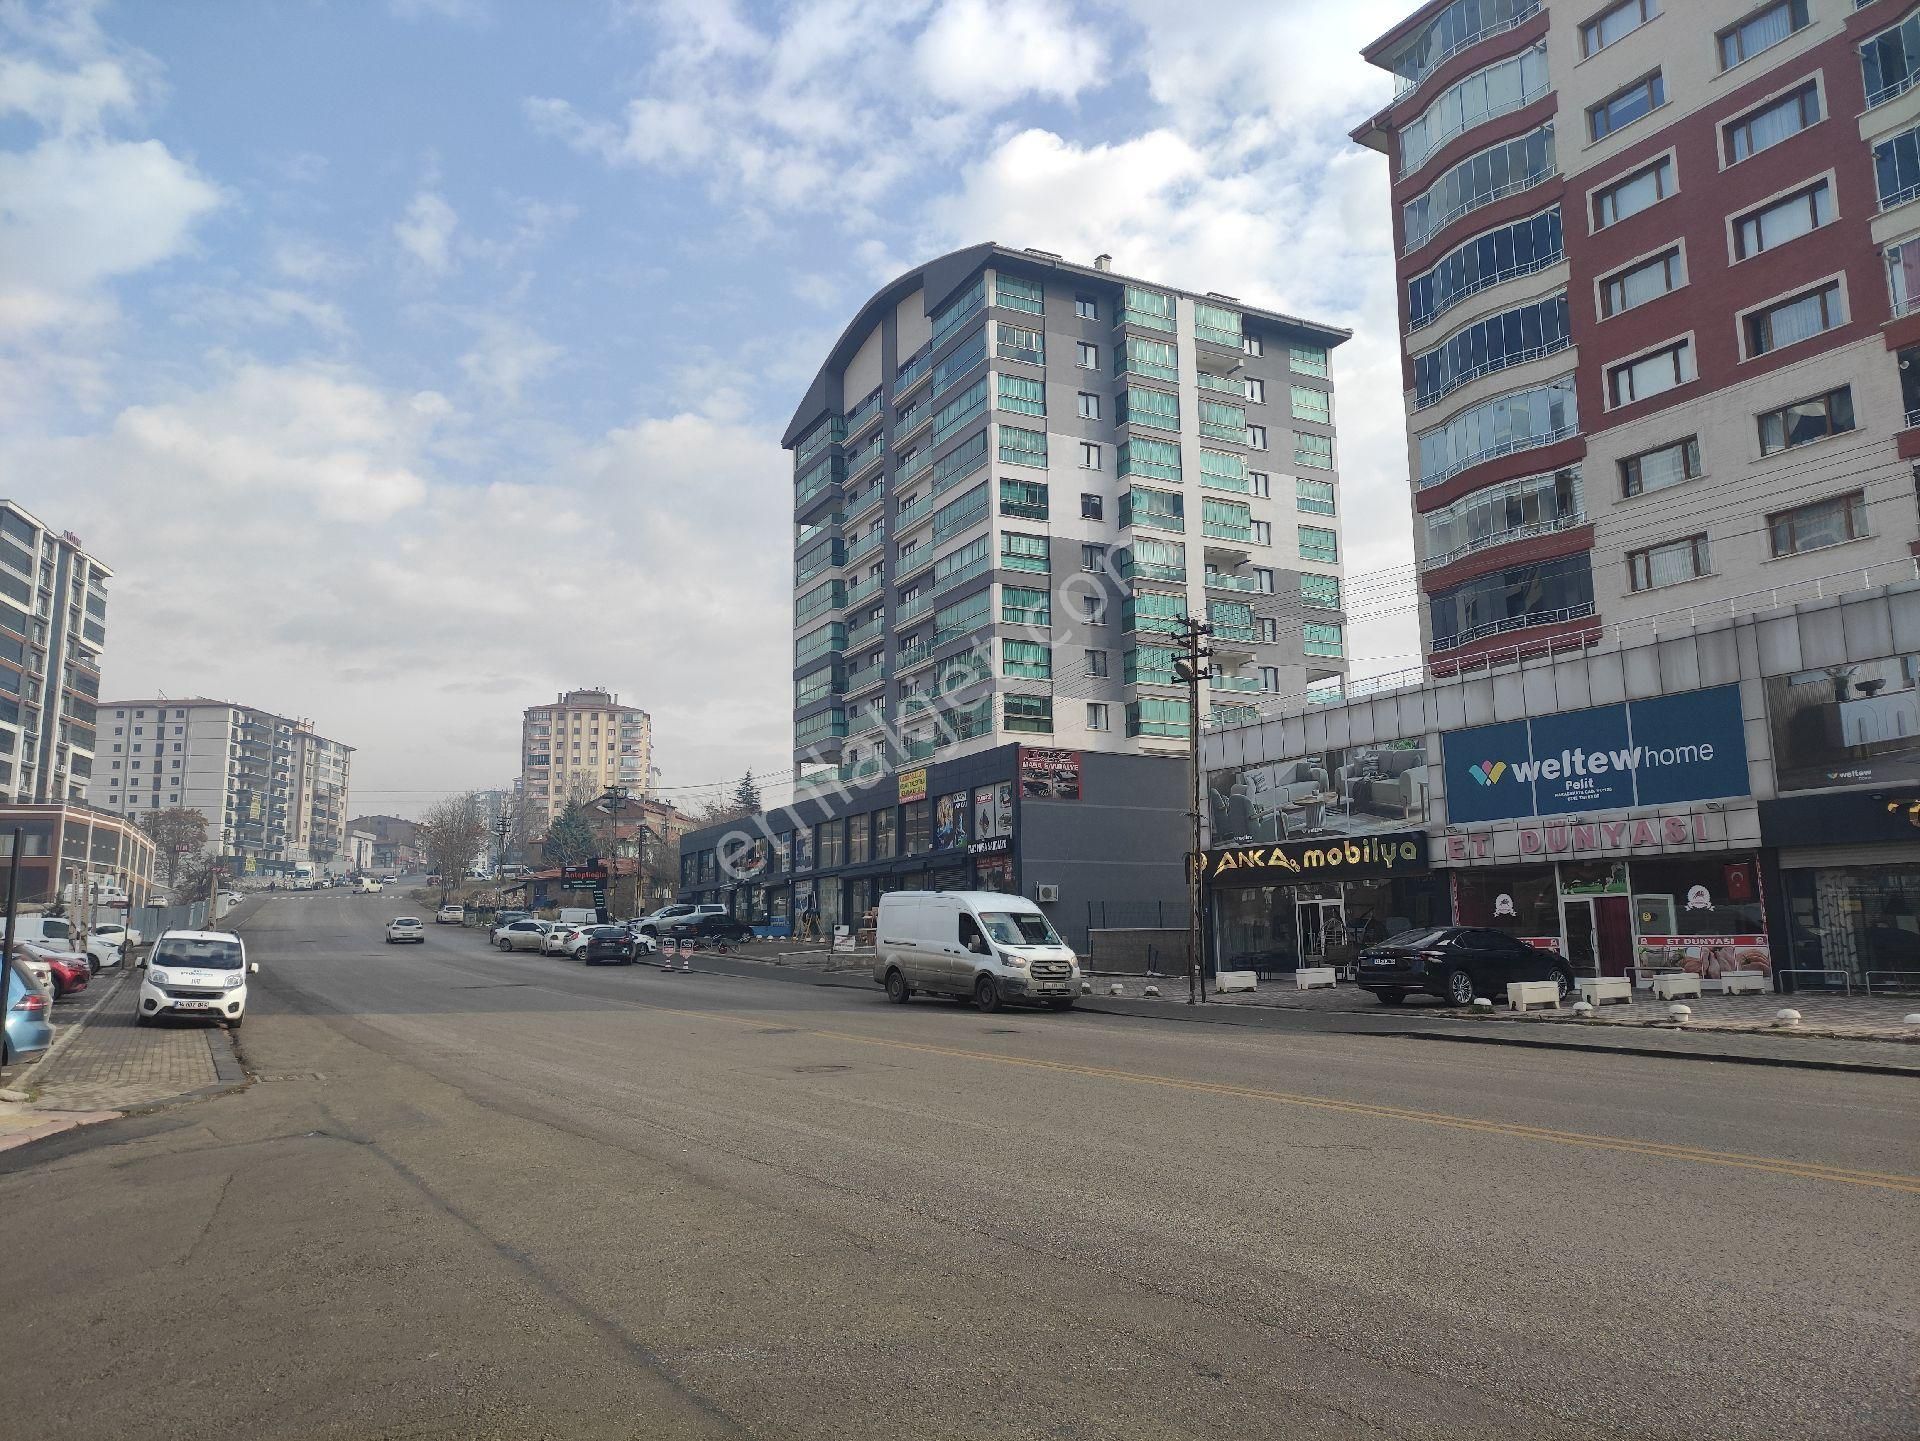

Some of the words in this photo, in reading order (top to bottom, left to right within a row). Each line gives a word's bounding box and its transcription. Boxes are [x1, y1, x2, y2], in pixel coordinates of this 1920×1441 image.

[1212, 847, 1298, 879] ANKA
[1303, 837, 1417, 869] mobilya
[1447, 833, 1490, 859] ET
[1520, 815, 1709, 854] DÜNYASI
